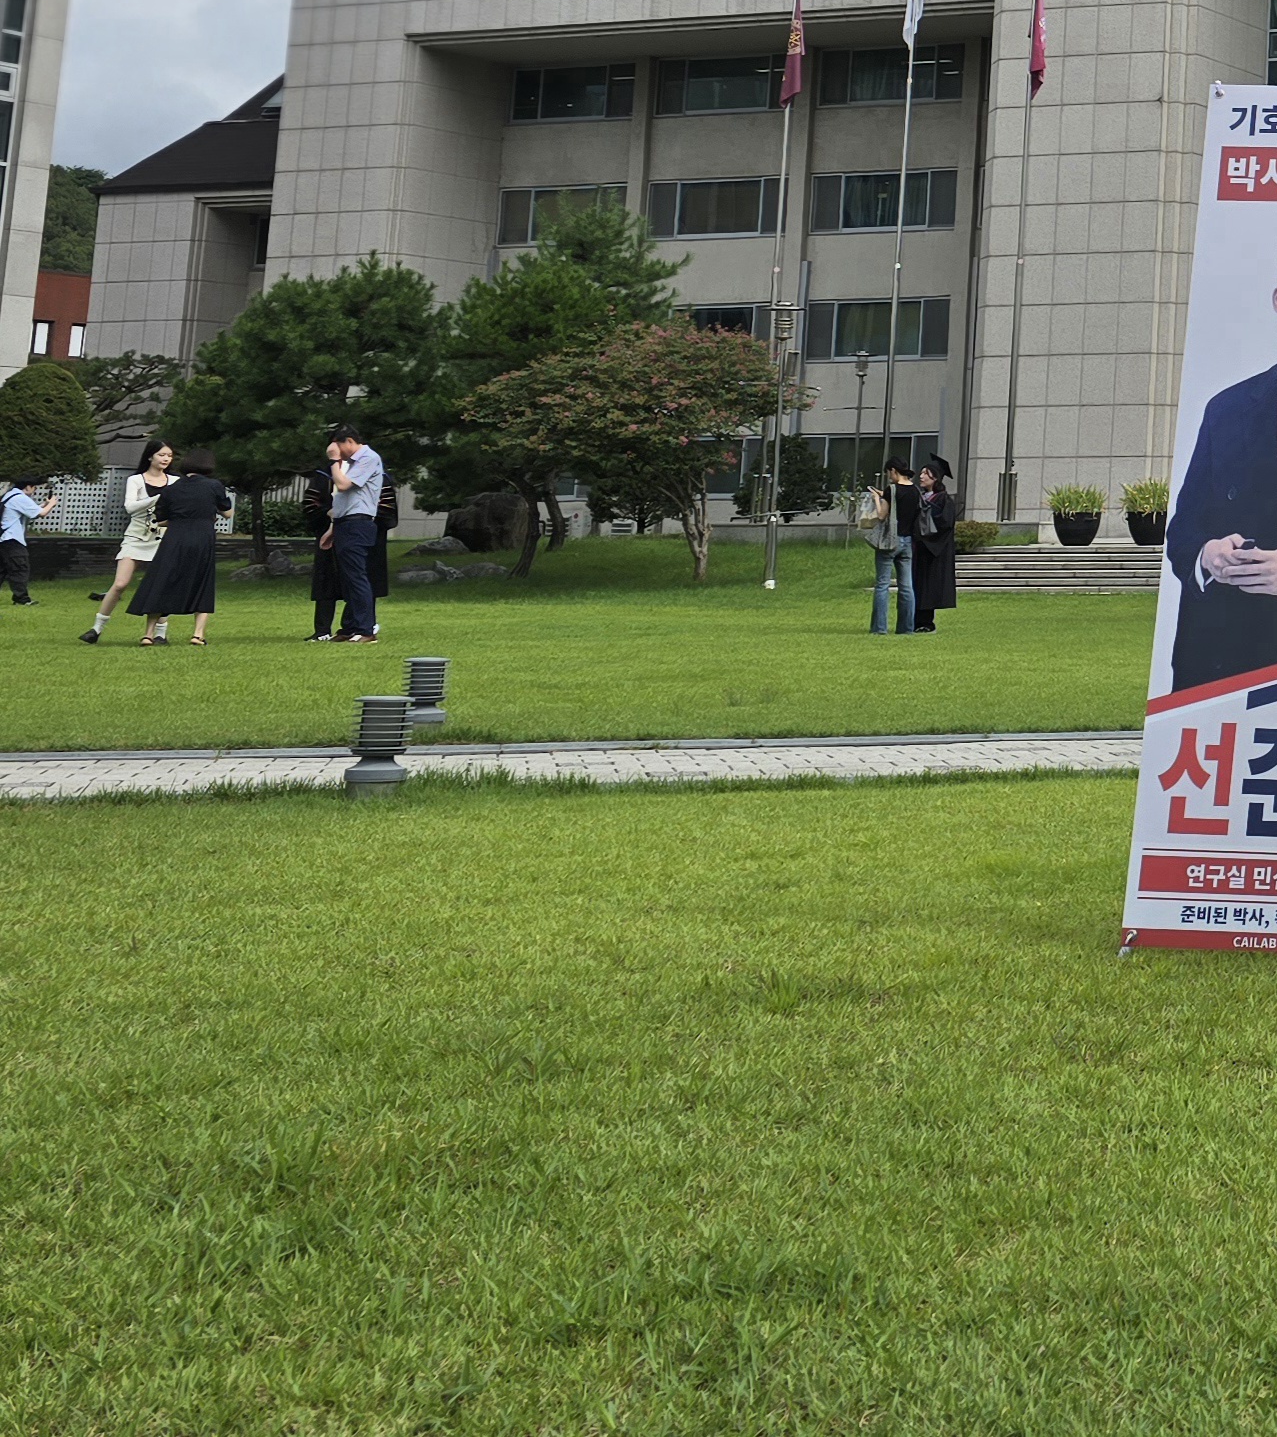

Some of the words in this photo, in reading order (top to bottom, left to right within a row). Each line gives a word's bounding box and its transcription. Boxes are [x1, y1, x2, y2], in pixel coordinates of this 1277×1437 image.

[1186, 864, 1246, 890] 연구실
[1180, 906, 1228, 925] 준비된
[1232, 908, 1270, 928] 박사,
[1233, 936, 1277, 949] CAILAB
